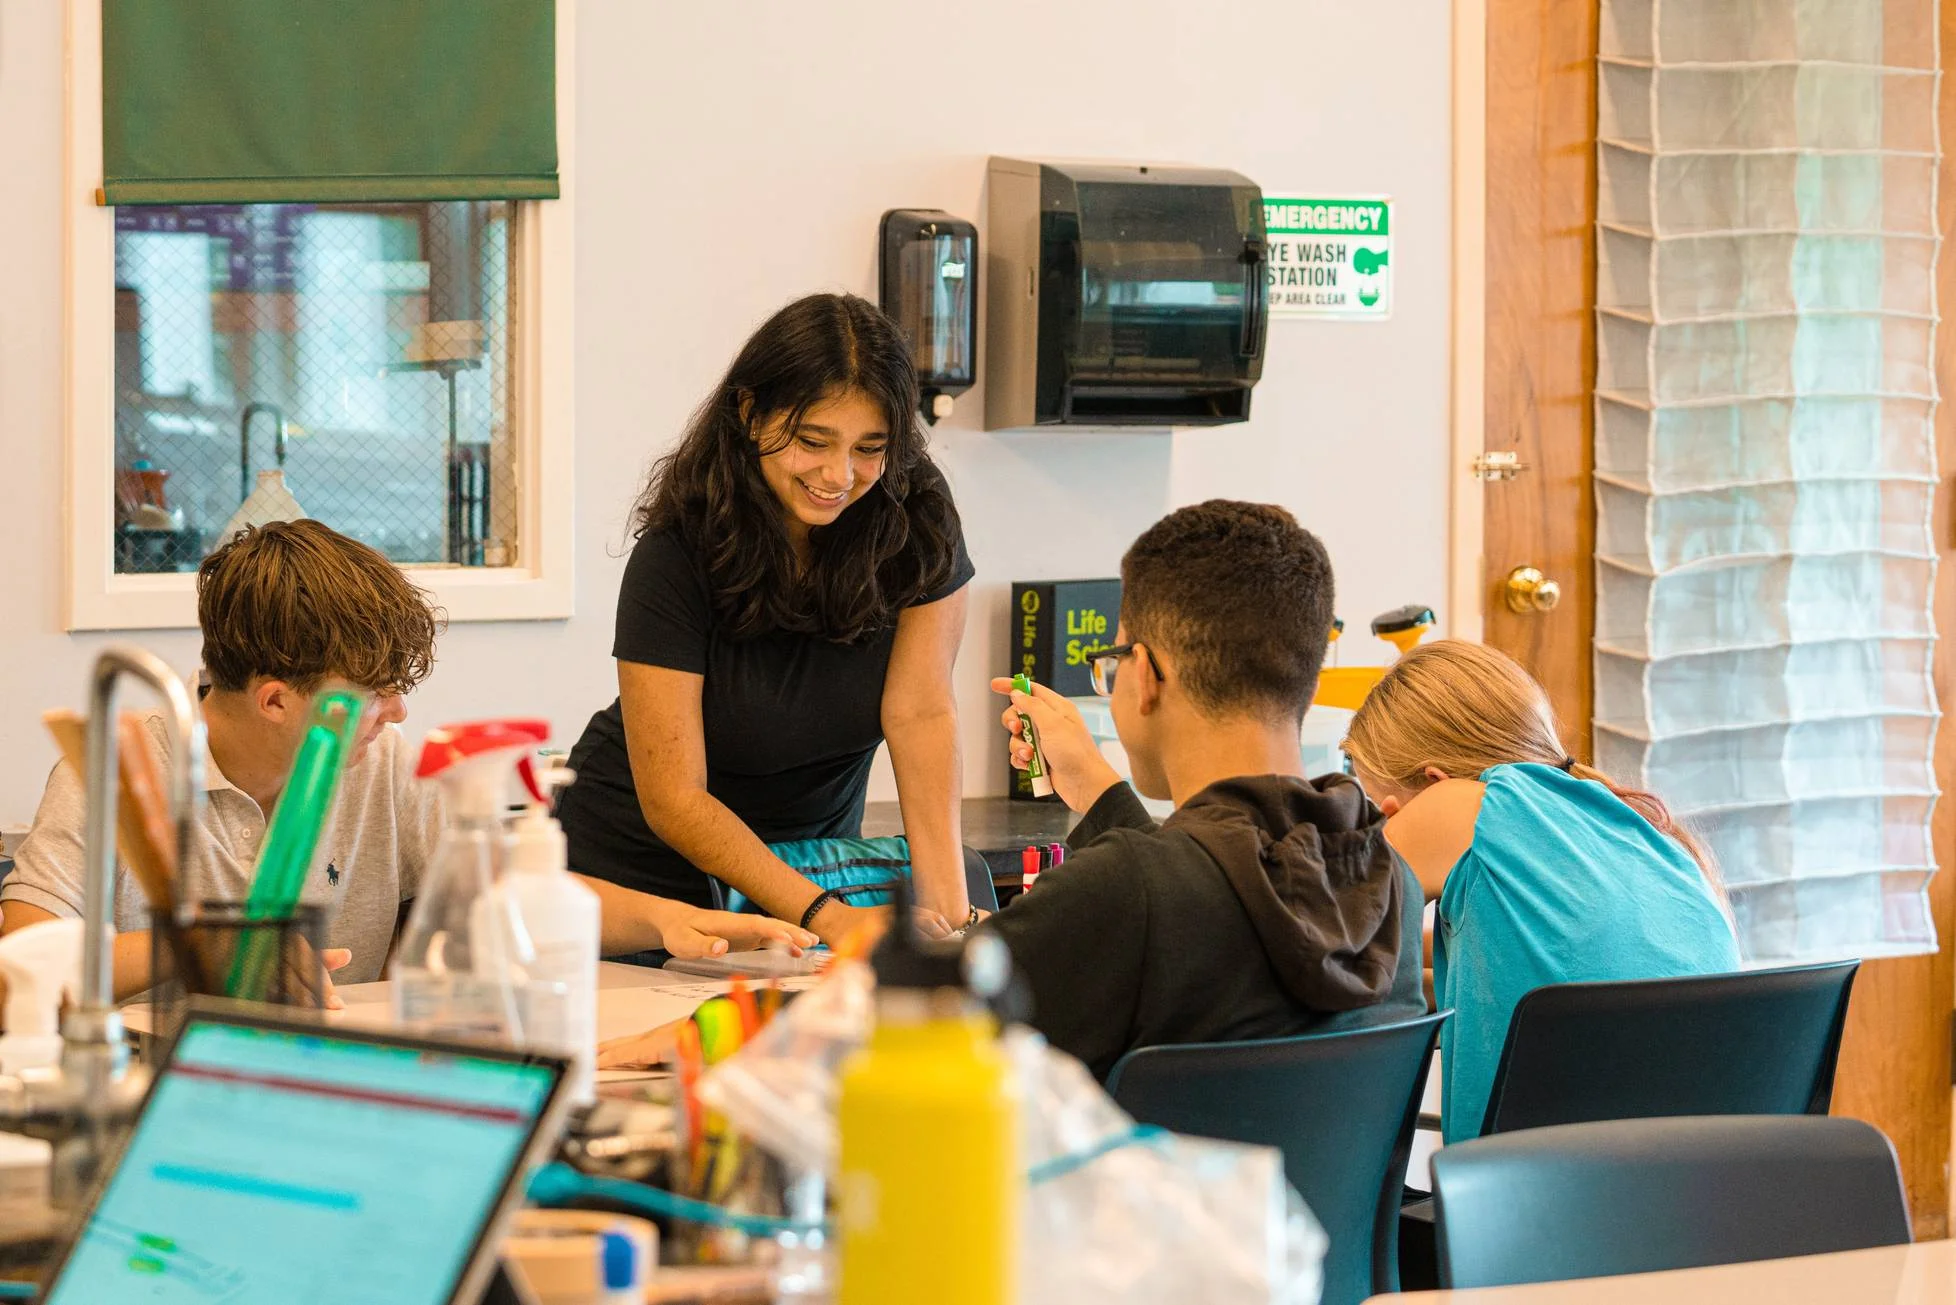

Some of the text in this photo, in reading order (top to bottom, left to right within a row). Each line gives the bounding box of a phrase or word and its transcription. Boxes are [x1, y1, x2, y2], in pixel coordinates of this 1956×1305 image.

[1267, 243, 1346, 263] YE WASH
[1267, 267, 1337, 287] STATION
[1285, 293, 1311, 305] AREA
[1315, 293, 1346, 305] CLEAR
[1066, 609, 1107, 636] Life
[1065, 638, 1115, 666] Sci
